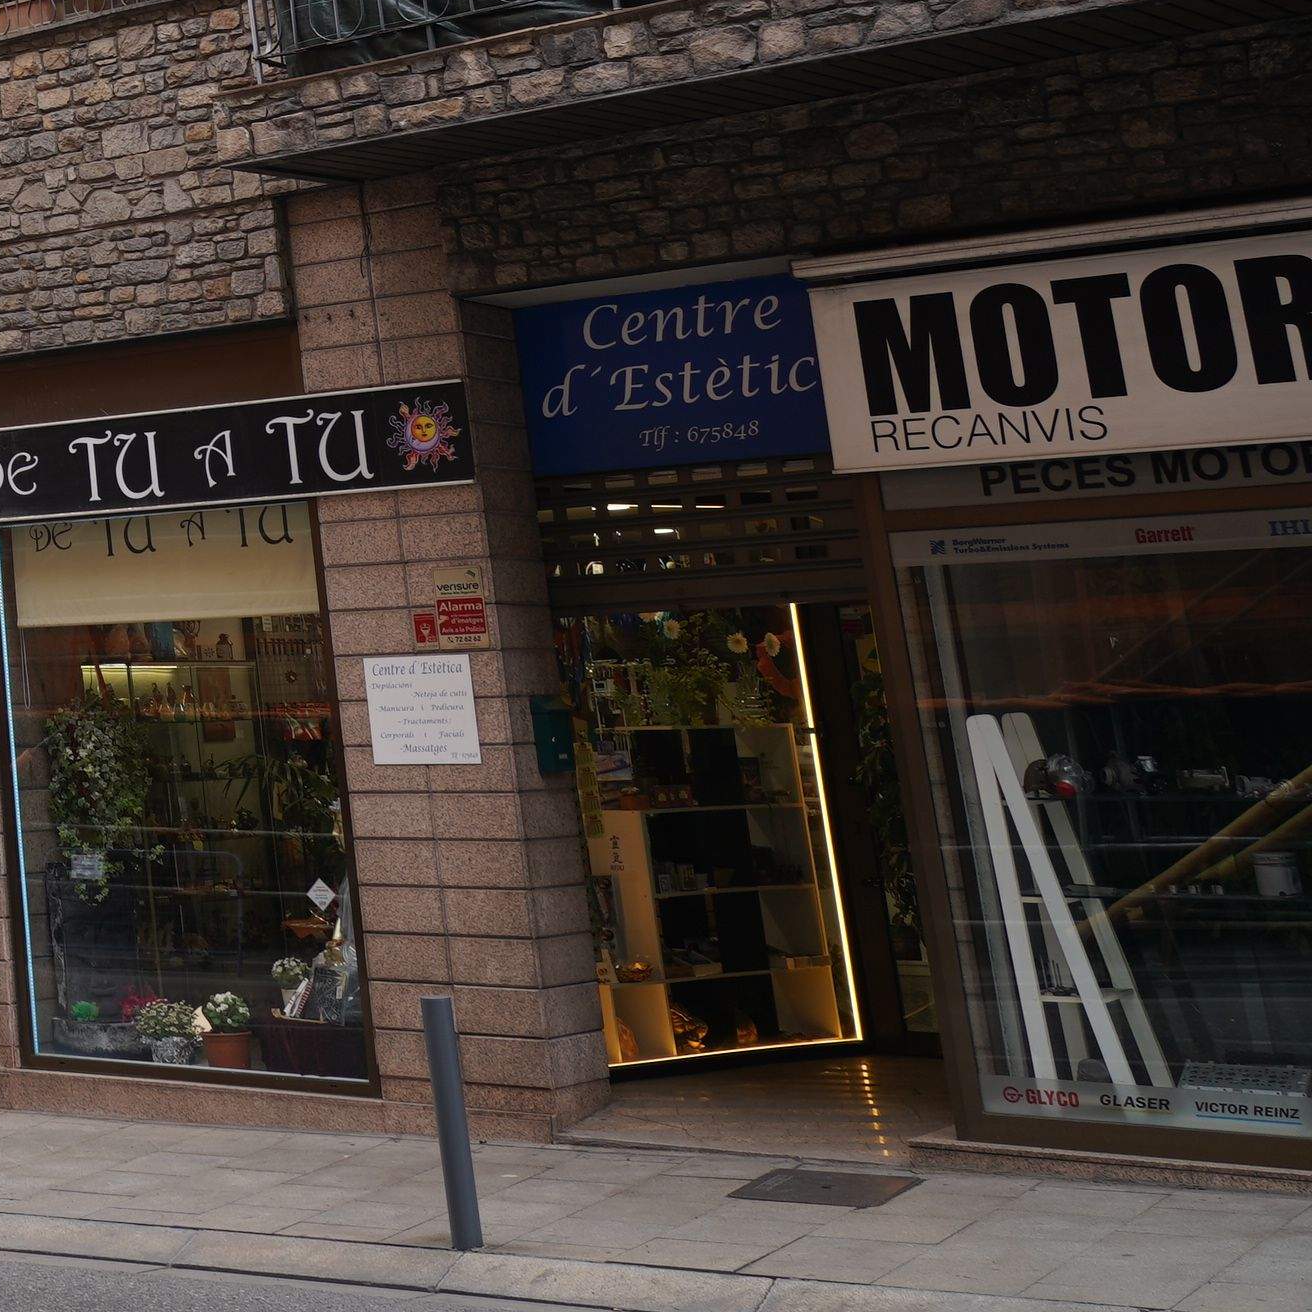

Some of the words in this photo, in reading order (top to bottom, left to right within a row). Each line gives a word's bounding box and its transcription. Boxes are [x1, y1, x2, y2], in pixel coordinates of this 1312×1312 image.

[582, 292, 783, 352] Centre
[687, 418, 760, 445] 675848
[871, 405, 1109, 453] RECANVIS
[68, 431, 166, 502] TU
[193, 429, 236, 487] A
[265, 409, 375, 485] TU
[979, 454, 1137, 497] PECES
[29, 522, 74, 552] DE
[1134, 525, 1194, 544] Garrett
[436, 583, 480, 592] verisure
[438, 602, 483, 612] Alarma
[372, 663, 407, 676] Centre
[1025, 1089, 1080, 1108] GLYCO
[1099, 1094, 1171, 1111] GLASER
[1195, 1100, 1249, 1116] VICTOR
[1253, 1104, 1300, 1119] REINZ
